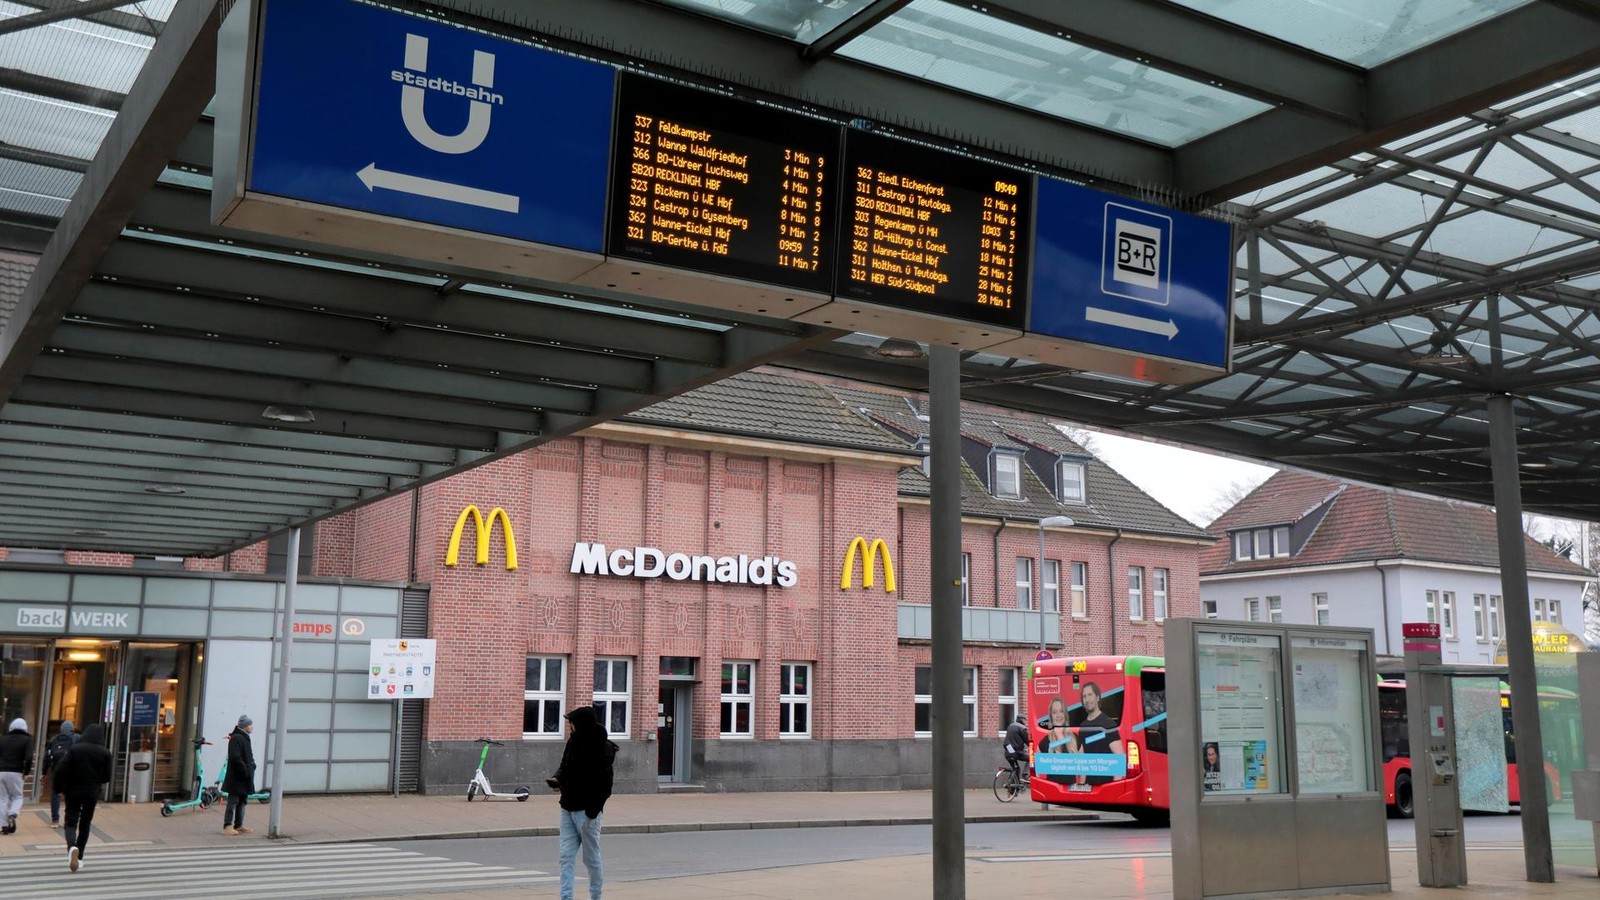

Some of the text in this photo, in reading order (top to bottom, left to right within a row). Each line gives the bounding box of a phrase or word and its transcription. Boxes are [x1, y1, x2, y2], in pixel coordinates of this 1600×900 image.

[391, 70, 504, 105] stadtbahn
[634, 131, 823, 182] 312 Wanne Waldfriedhof 4 Min 9
[635, 115, 652, 128] 337
[785, 150, 791, 160] 3
[795, 152, 810, 165] Min
[818, 158, 824, 167] 9
[631, 163, 654, 177] SB20
[706, 178, 721, 191] HBF
[782, 195, 788, 205] 4
[792, 197, 807, 209] Min
[816, 202, 821, 212] 5
[633, 147, 650, 161] 366
[706, 163, 749, 184] Luchsweg
[783, 180, 788, 190] 4
[793, 182, 808, 194] Min
[817, 187, 822, 197] 9
[858, 167, 872, 180] 362
[984, 197, 992, 208] 12
[995, 200, 1009, 211] Min
[1011, 204, 1016, 213] 4
[995, 181, 1017, 196] 09:49
[630, 195, 647, 208] 324
[654, 200, 689, 218] Castrop
[702, 209, 748, 230] Gysenberg
[780, 225, 786, 235] 9
[790, 226, 805, 238] Min
[814, 231, 819, 241] 2
[631, 179, 648, 191] 323
[655, 184, 689, 200] Bickern
[702, 193, 714, 205] WE
[717, 196, 733, 211] Hbf
[781, 210, 787, 220] 8
[791, 212, 806, 224] Min
[815, 217, 820, 227] 8
[856, 196, 875, 210] SB20
[917, 210, 931, 221] HBF
[982, 225, 1001, 237] 10:03
[1010, 231, 1015, 240] 5
[857, 182, 870, 194] 311
[877, 187, 906, 204] Castrop
[983, 211, 992, 221] 13
[995, 214, 1008, 225] Min
[1011, 218, 1016, 226] 6
[628, 227, 644, 239] 321
[652, 231, 698, 249] BO-Gerthe
[779, 255, 788, 266] 11
[793, 257, 808, 269] Min
[812, 261, 818, 271] 7
[629, 211, 819, 256] 362 Wanne-Eickel Hbf 09:59 2
[854, 225, 868, 237] 323
[874, 230, 914, 248] BO-Hiltrop
[981, 253, 989, 263] 18
[992, 255, 1005, 266] Min
[1009, 259, 1013, 267] 1
[855, 211, 870, 223] 303
[875, 215, 916, 234] Regenkamp
[927, 226, 938, 237] MH
[981, 239, 990, 249] 18
[993, 241, 1006, 252] Min
[1009, 245, 1014, 254] 2
[1118, 238, 1156, 270] B+R
[852, 255, 866, 266] 311
[979, 280, 988, 290] 28
[991, 282, 1004, 293] Min
[1007, 286, 1012, 295] 6
[853, 240, 1013, 281] 362 Wanne-Eickel Hbf 25 Min 2
[851, 269, 866, 280] 312
[872, 273, 885, 285] HER
[978, 294, 987, 304] 28
[990, 296, 1003, 307] Min
[1007, 299, 1011, 308] 1
[570, 542, 798, 588] McDonald's
[20, 610, 129, 628] back WERK
[282, 619, 333, 637] amps
[1228, 634, 1258, 644] Fahrpläne
[1317, 639, 1347, 647] Information
[1072, 660, 1088, 672] 390
